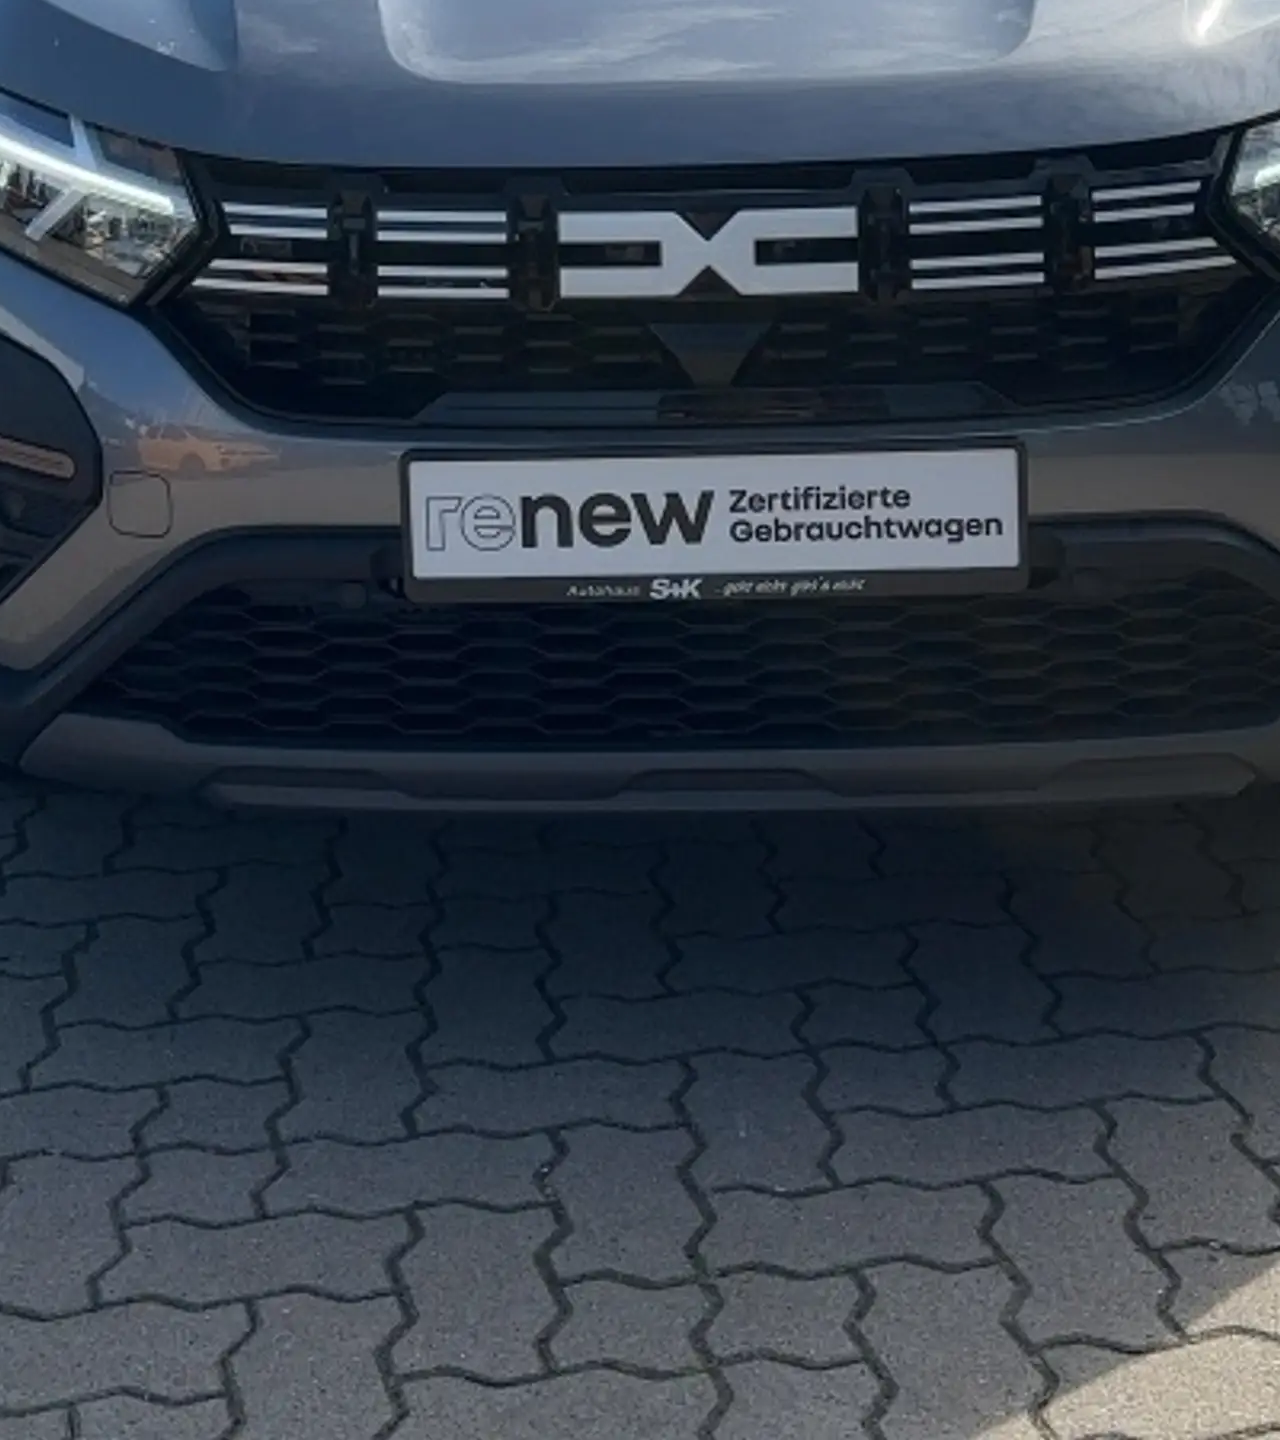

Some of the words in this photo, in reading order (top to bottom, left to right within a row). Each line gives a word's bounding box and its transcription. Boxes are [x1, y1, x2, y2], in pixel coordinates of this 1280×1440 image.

[728, 485, 912, 514] Zertifizierte
[426, 490, 715, 551] renew
[729, 515, 1004, 545] Gebrauchtwagen
